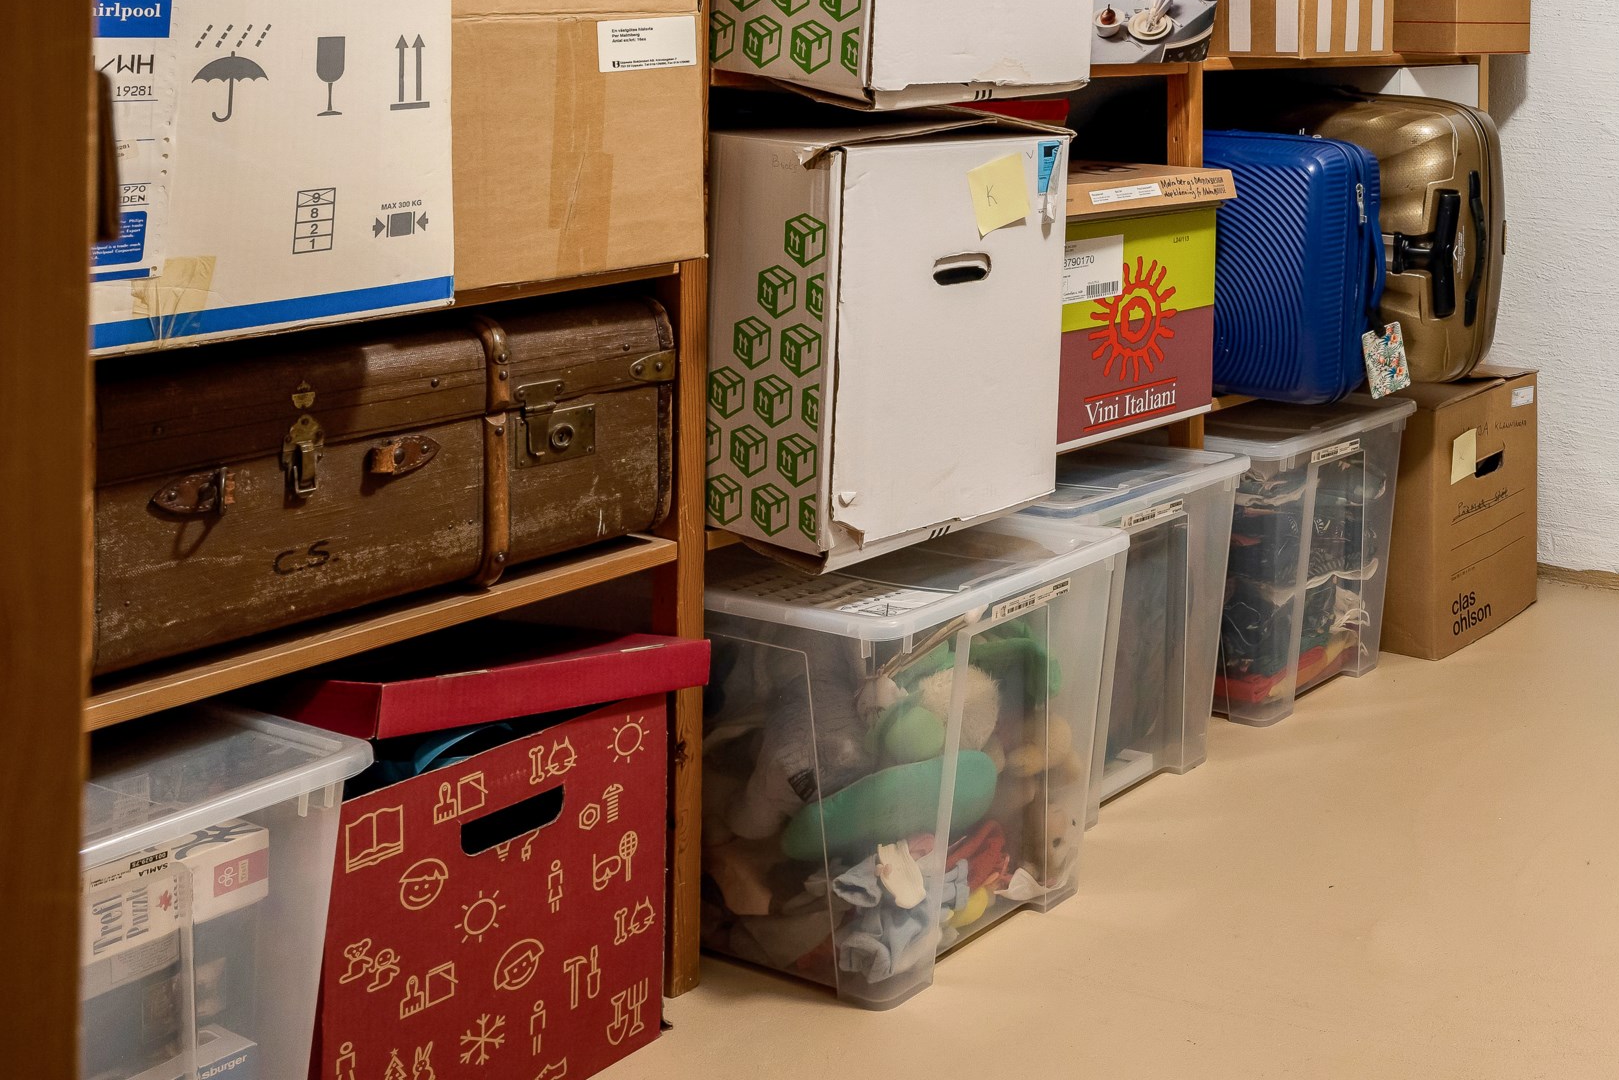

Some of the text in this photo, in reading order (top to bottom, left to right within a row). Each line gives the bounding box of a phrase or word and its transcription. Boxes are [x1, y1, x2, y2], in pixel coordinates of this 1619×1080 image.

[116, 85, 153, 97] 19281
[986, 184, 998, 207] K
[381, 199, 422, 210] MAX 300 KG
[310, 208, 319, 219] 8
[310, 223, 319, 235] 2
[309, 238, 316, 249] 1
[1085, 382, 1176, 425] Vini Italiani
[1452, 591, 1476, 616] clas
[1453, 603, 1491, 636] ohlson
[138, 862, 168, 877] SAMLA
[92, 894, 123, 955] Trefl
